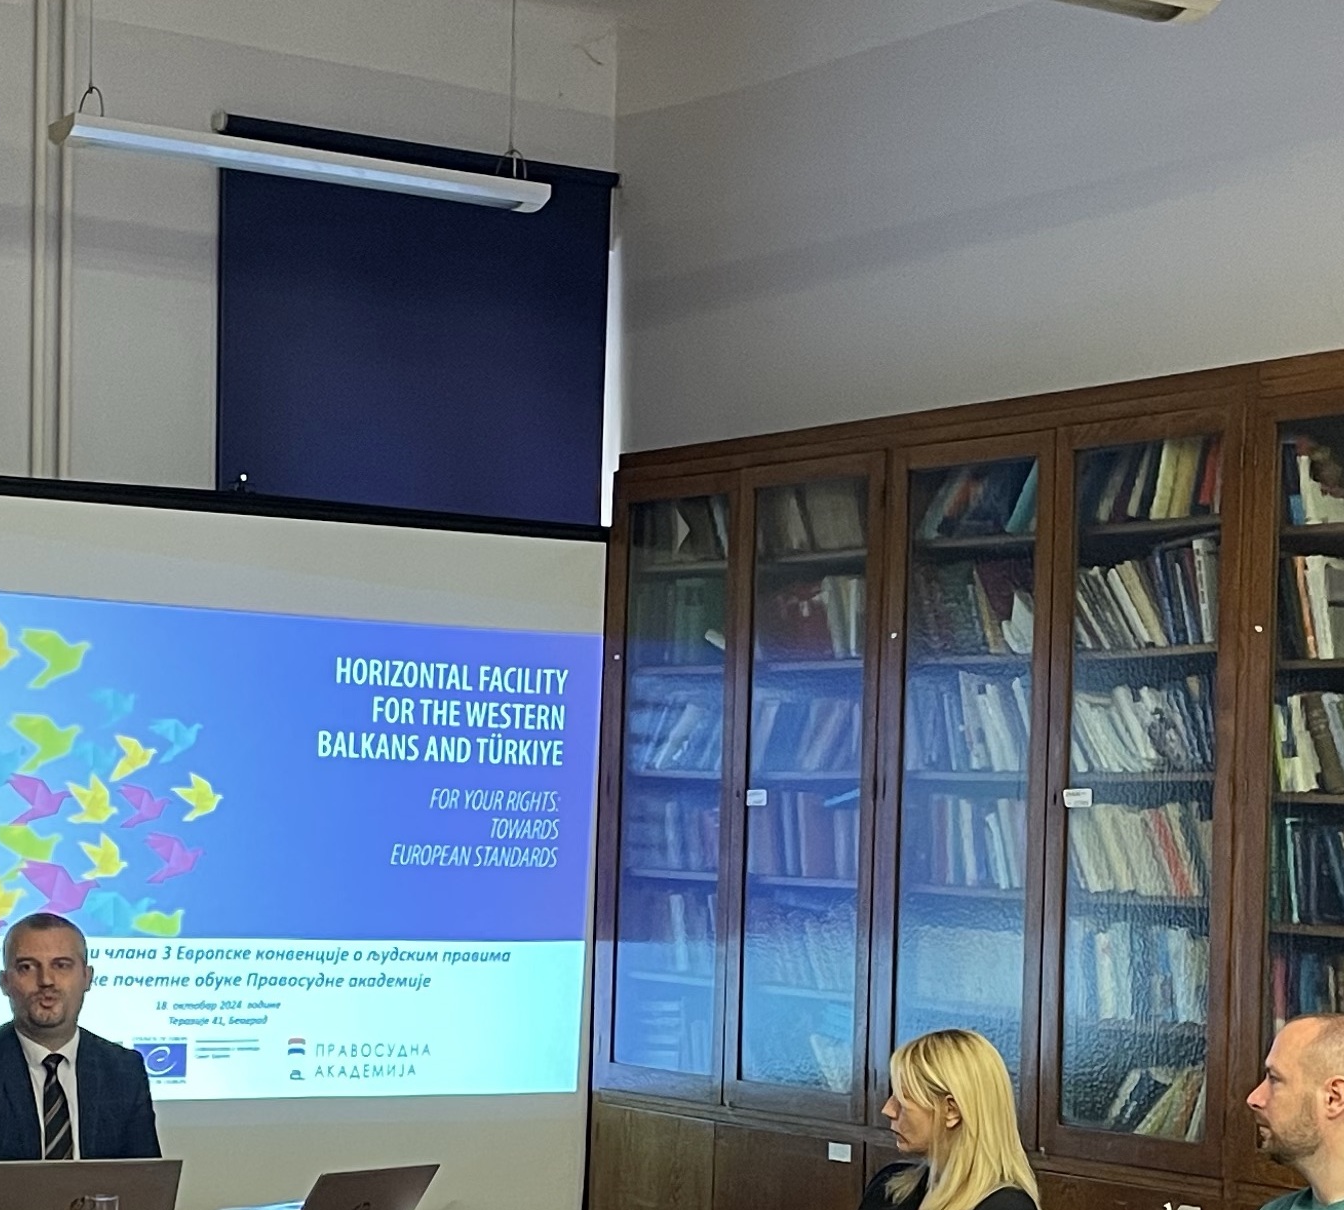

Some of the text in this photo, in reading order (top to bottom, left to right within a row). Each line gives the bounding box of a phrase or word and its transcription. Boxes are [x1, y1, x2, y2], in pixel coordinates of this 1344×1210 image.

[336, 657, 568, 695] HORIZONTAL FACILITY
[372, 696, 565, 730] FOR THE WESTERN
[317, 730, 563, 766] BALKANS AND TÜRKIYE
[429, 788, 460, 809] FOR
[464, 789, 504, 811] YOUR
[490, 817, 560, 840] TOWARDS
[390, 843, 558, 868] EUROPEAN STANDARDS
[104, 947, 157, 960] члана
[162, 946, 172, 960] 3
[176, 946, 251, 964] Европске
[255, 947, 350, 965] конвенције
[353, 950, 362, 961] о
[365, 947, 438, 965] људским
[441, 950, 511, 966] правима
[113, 974, 190, 988] почетне
[195, 972, 242, 990] обуке
[246, 972, 344, 992] Правосудне
[348, 972, 432, 992] академије
[315, 1043, 432, 1058] ПРАВОСУДНА
[315, 1064, 417, 1080] АКАДЕМИЈА
